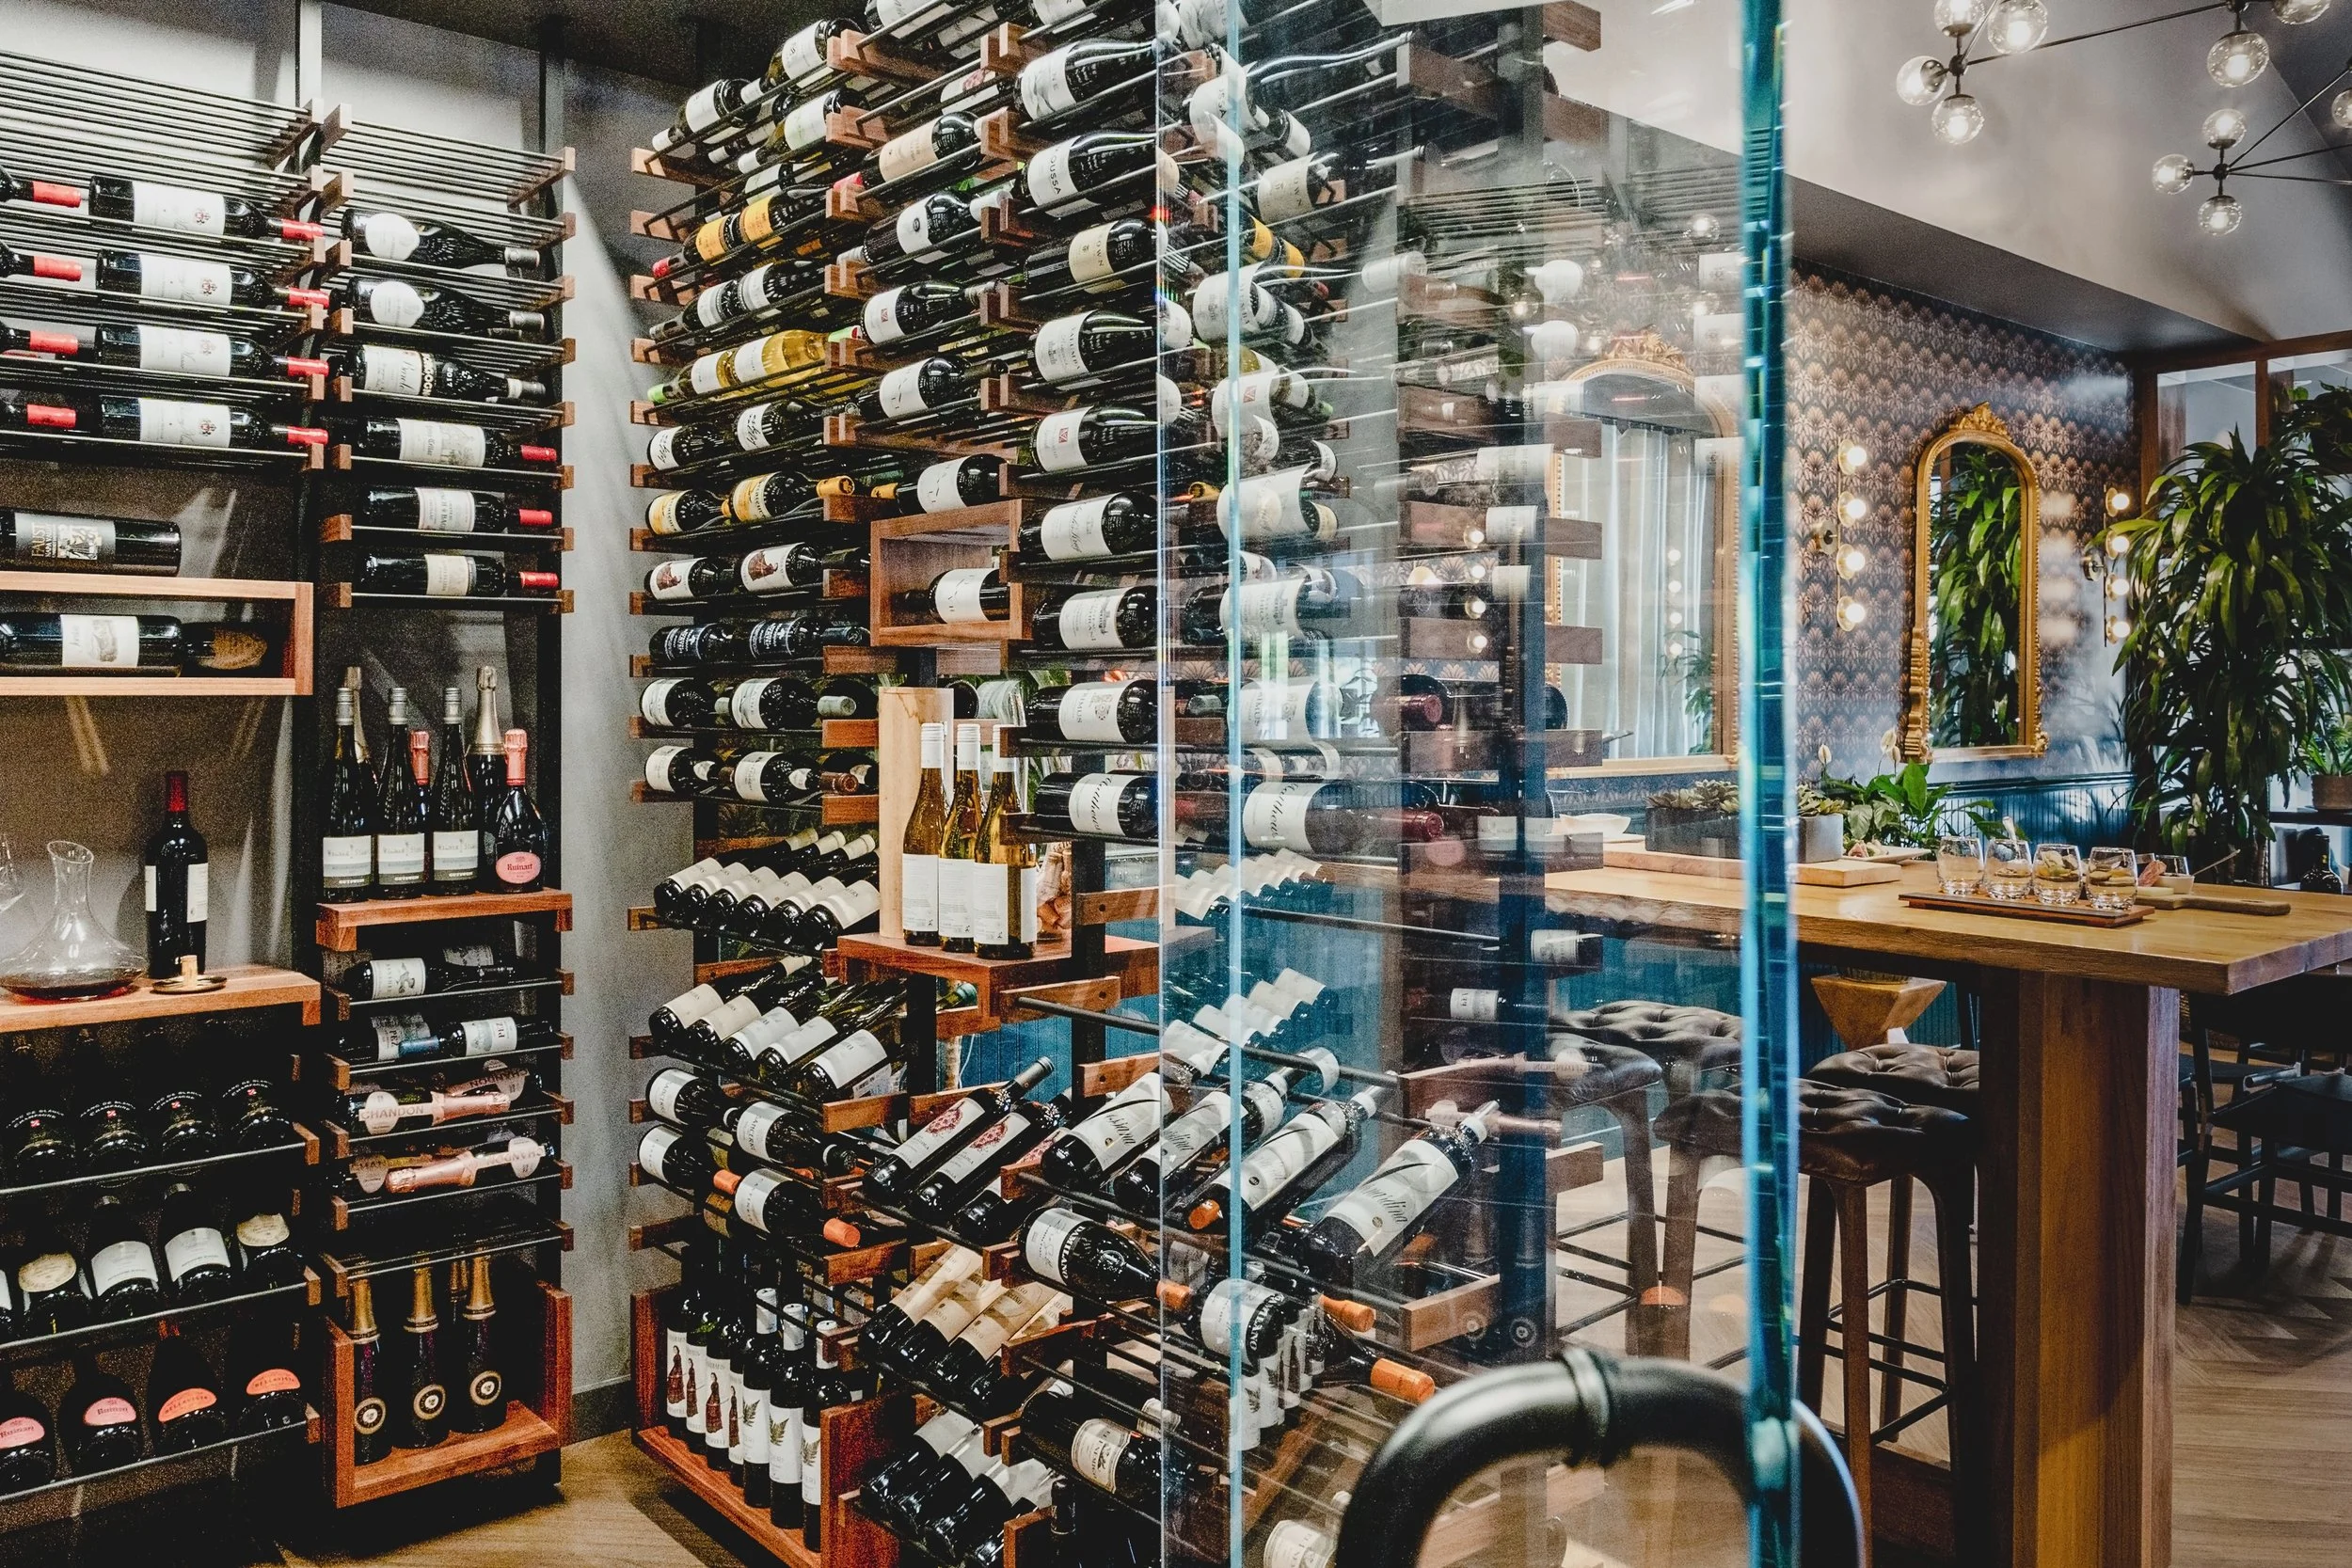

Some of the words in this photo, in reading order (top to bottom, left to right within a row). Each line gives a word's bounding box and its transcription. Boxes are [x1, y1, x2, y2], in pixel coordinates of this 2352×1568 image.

[31, 522, 46, 557] FAUST
[506, 863, 533, 871] Ruinart
[470, 1068, 529, 1088] CHANDON
[360, 1103, 424, 1121] CHANDON
[485, 1146, 544, 1166] CHANDON
[1057, 1225, 1086, 1280] DAMILANO
